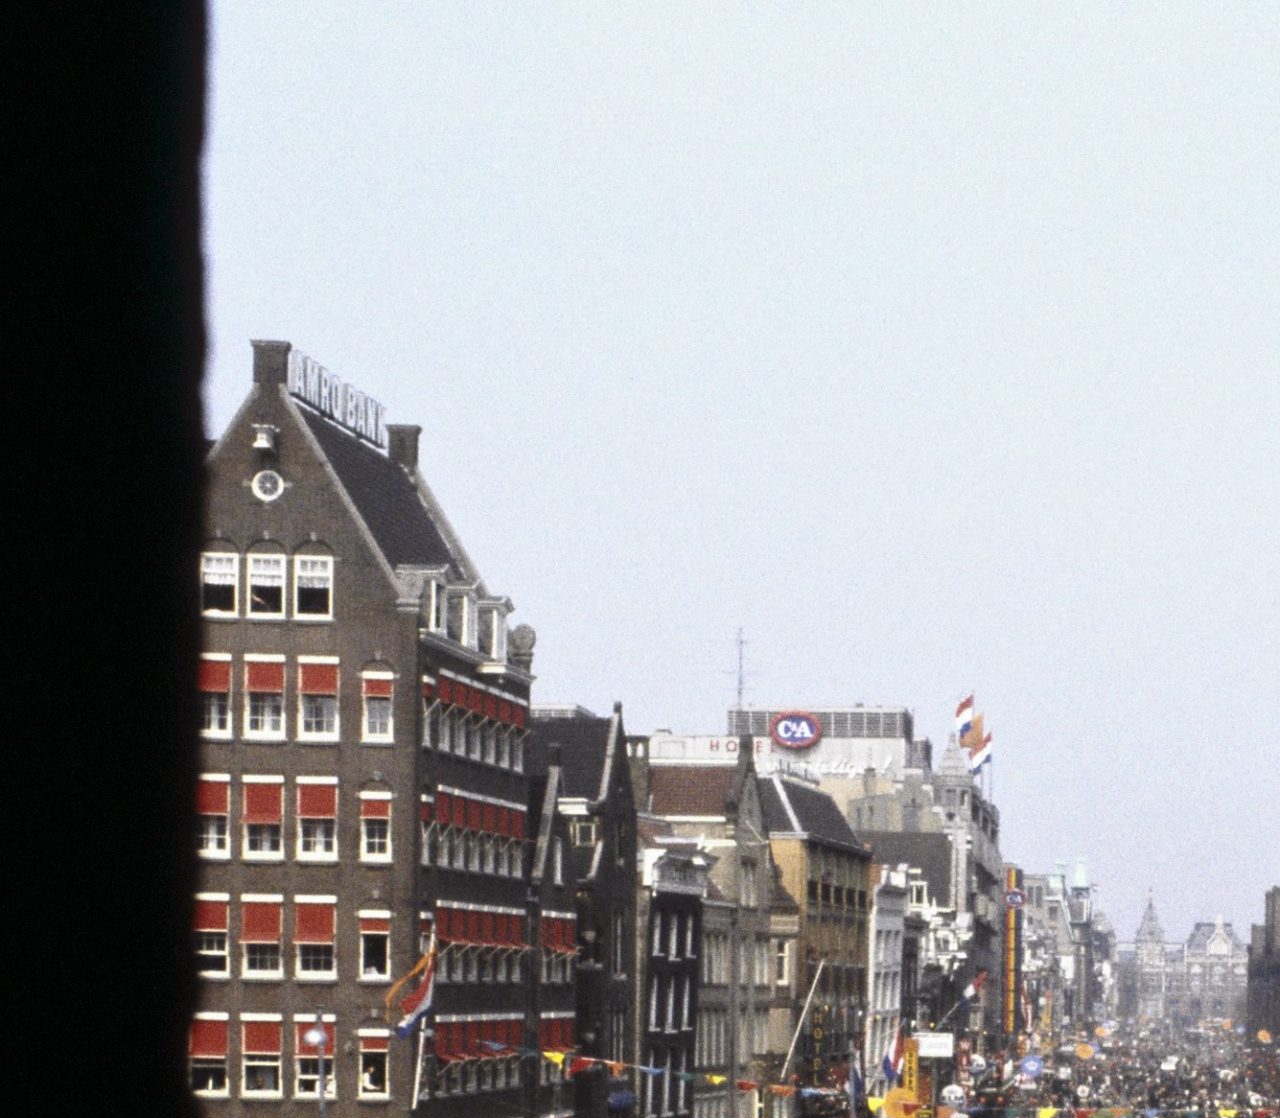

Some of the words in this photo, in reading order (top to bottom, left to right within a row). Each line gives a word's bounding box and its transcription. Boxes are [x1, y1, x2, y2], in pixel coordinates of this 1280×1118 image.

[777, 720, 811, 738] C&A
[709, 741, 775, 755] HOEL
[1006, 894, 1022, 904] CA
[813, 1010, 823, 1086] HOTEL
